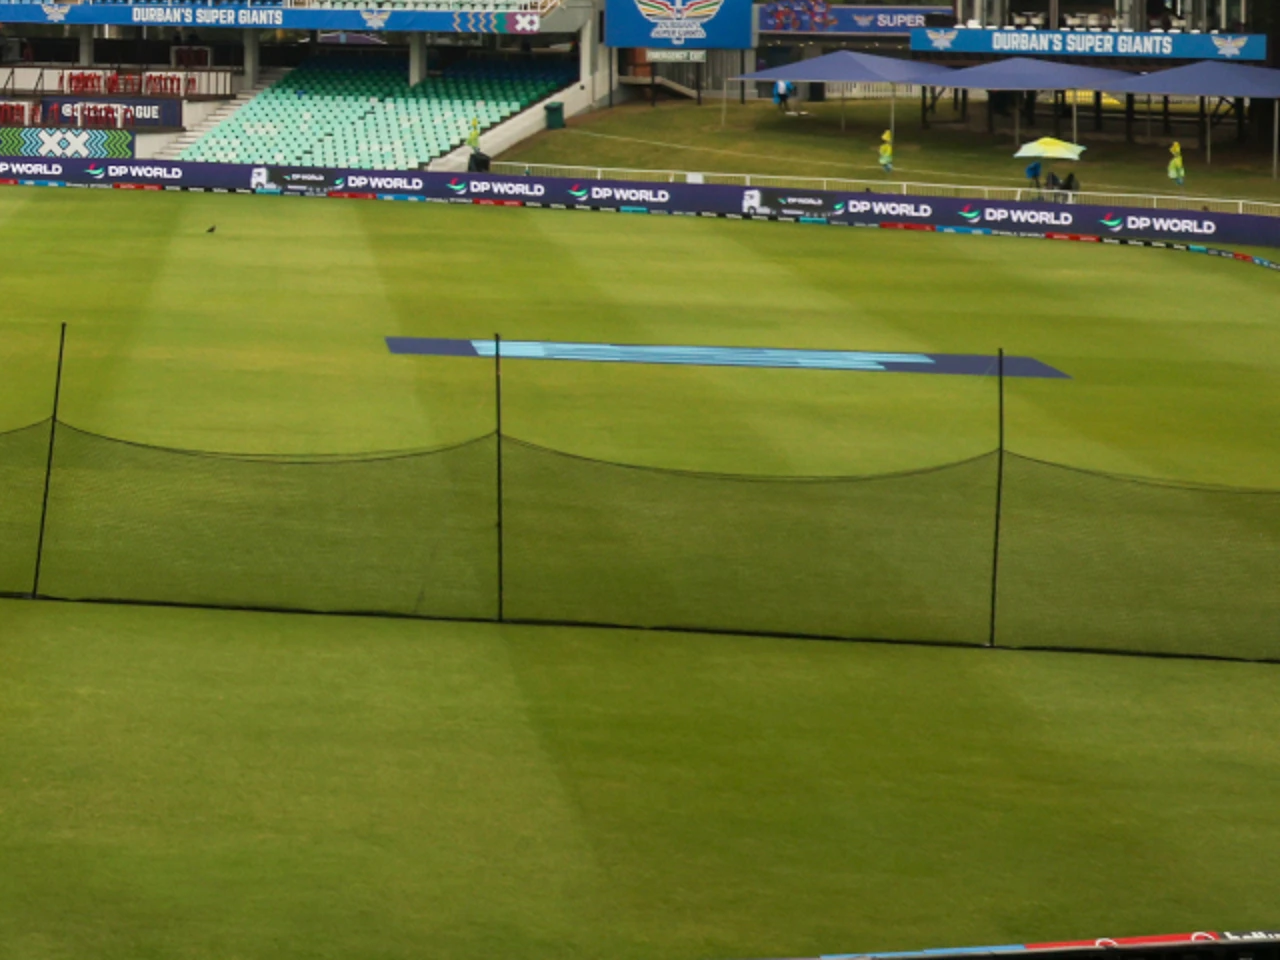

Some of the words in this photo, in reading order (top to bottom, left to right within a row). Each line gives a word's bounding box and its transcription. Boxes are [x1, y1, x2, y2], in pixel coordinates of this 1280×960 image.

[132, 6, 193, 24] DURBAN'S
[195, 8, 235, 25] SUPER
[238, 9, 283, 26] GIANTS
[877, 13, 926, 27] SUPER
[992, 31, 1062, 52] DURBAN'S
[1067, 33, 1113, 53] SUPER
[1118, 35, 1173, 55] GIANTS
[12, 162, 63, 176] WORLD
[108, 164, 128, 177] DP
[130, 165, 183, 180] WORLD
[347, 175, 368, 188] DP
[369, 176, 424, 191] WORLD
[470, 180, 491, 194] DP
[493, 182, 546, 197] WORLD
[591, 186, 613, 200] DP
[614, 187, 670, 203] WORLD
[848, 199, 872, 214] DP
[873, 202, 933, 218] WORLD
[984, 208, 1009, 222] DP
[1010, 209, 1074, 227] WORLD
[1127, 214, 1151, 230] DP
[1153, 216, 1217, 235] WORLD
